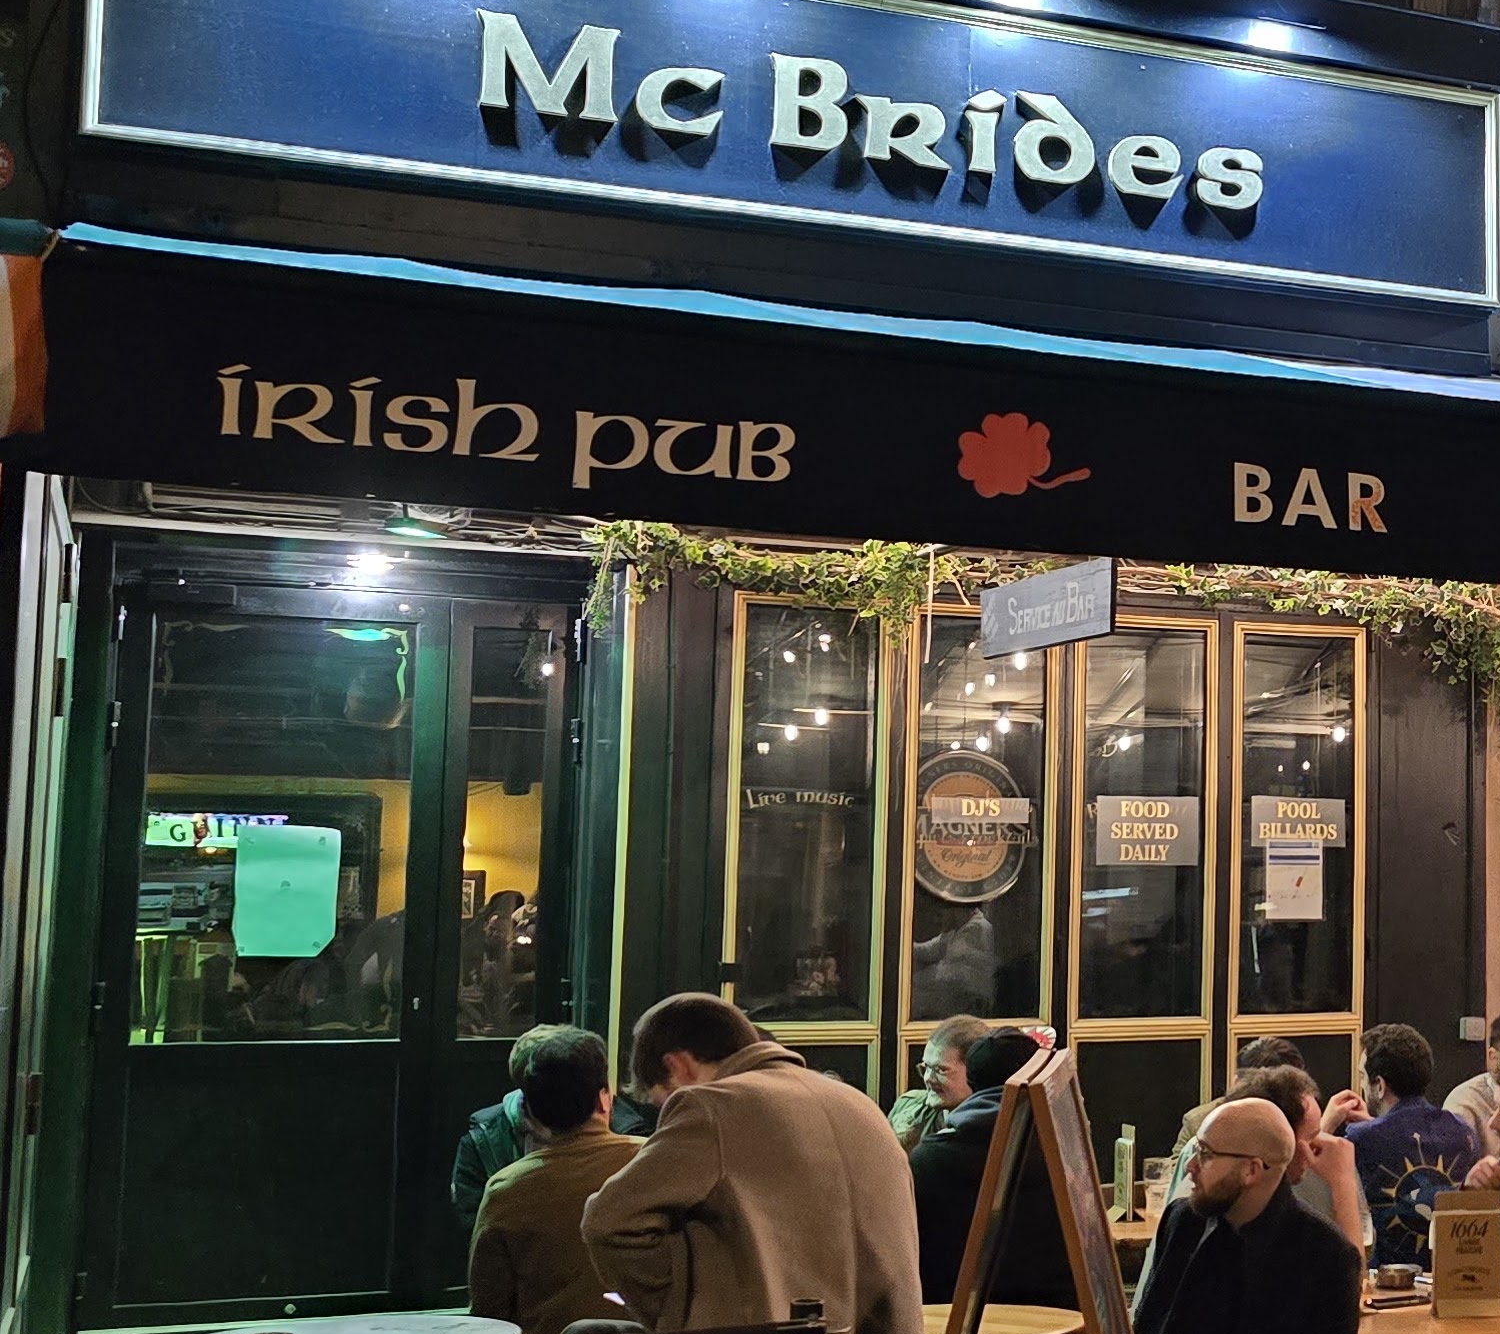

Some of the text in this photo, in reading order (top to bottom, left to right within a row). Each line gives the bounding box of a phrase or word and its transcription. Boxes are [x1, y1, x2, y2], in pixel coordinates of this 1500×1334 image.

[476, 8, 1265, 210] Mc Brides
[1233, 461, 1389, 534] BAR
[746, 788, 856, 809] Live music
[961, 798, 1001, 817] DJ'S
[1120, 799, 1171, 819] FOOD
[1276, 801, 1322, 819] POOL
[1110, 821, 1179, 840] SERVED
[1258, 822, 1338, 840] BILLARDS
[1119, 843, 1171, 862] DAILY
